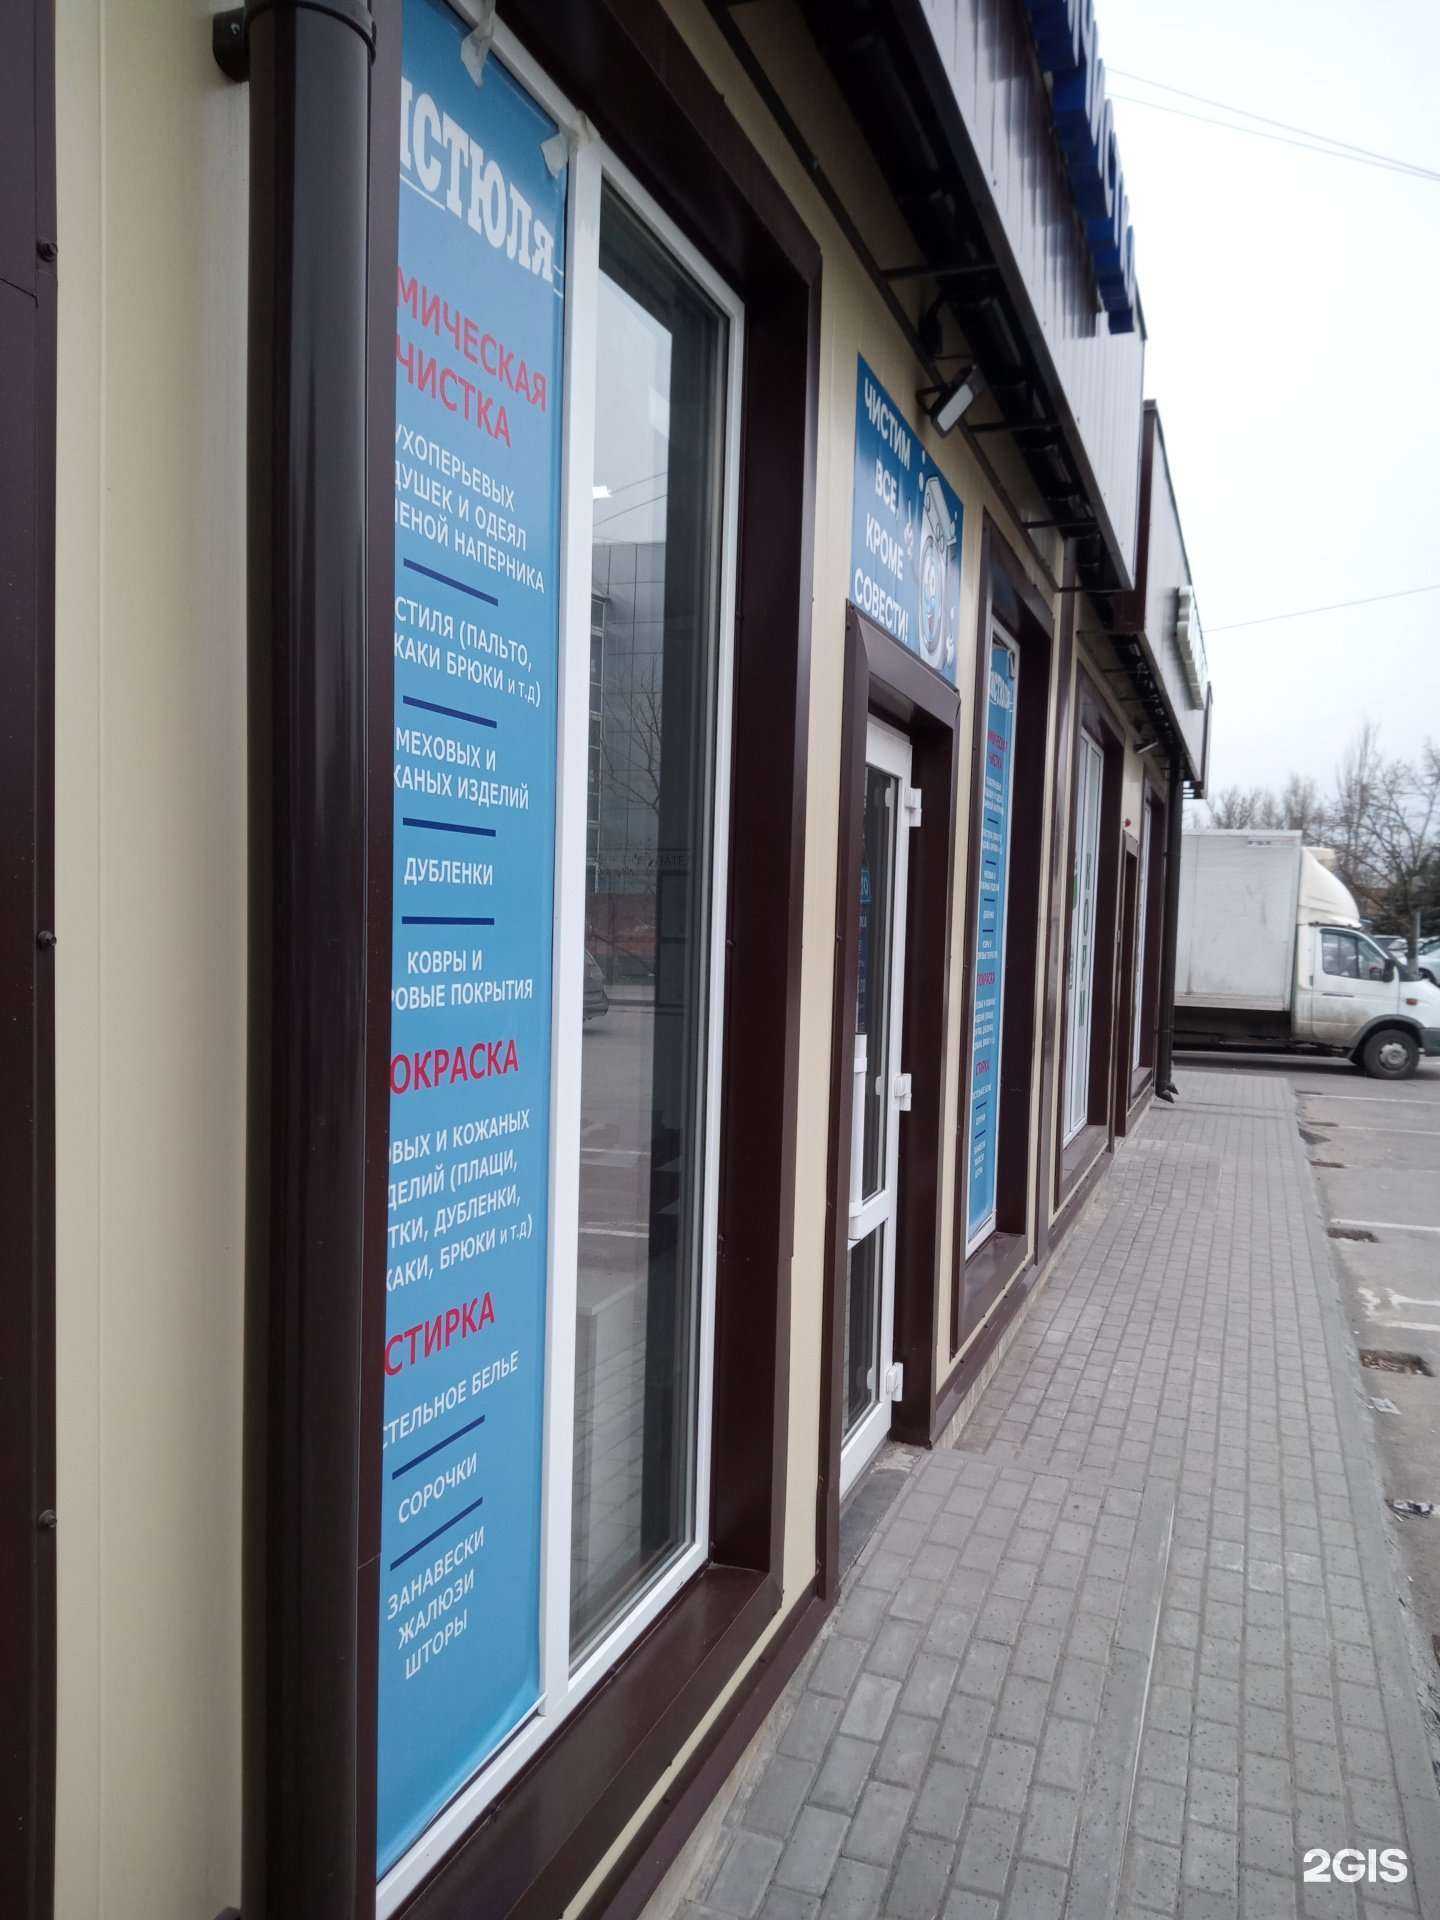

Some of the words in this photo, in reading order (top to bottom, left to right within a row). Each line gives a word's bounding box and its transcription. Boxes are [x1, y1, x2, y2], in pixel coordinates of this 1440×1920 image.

[396, 264, 547, 413] МИЧЕСКАЯ
[395, 334, 512, 449] ЧИСТКА
[864, 376, 912, 472] ЧИСТИМ
[874, 457, 901, 521] ВСЕ,
[395, 498, 449, 547] ЕНОЙ
[455, 529, 545, 593] НАПЕРНИКА
[458, 495, 470, 522] И
[475, 505, 527, 551] ОДЕЯЛ
[866, 512, 904, 581] КРОМЕ
[395, 596, 454, 640] СТИЛЯ
[459, 620, 532, 673] (ПАЛЬТО,
[854, 567, 910, 644] СОВЕСТИ!
[447, 651, 504, 691] БРЮКИ
[396, 727, 481, 769] МЕХОВЫХ
[486, 749, 496, 772] И
[457, 775, 529, 811] ИЗДЕЛИЙ
[403, 856, 494, 886] ДУБЛЕНКИ
[391, 984, 446, 1011] ОВЫЕ
[451, 978, 533, 1006] ПОКРЫТИЯ
[407, 949, 467, 975] КОВРЫ
[472, 949, 483, 971] И
[389, 1039, 519, 1095] ОКРАСКА
[389, 1133, 431, 1165] ВЫХ
[436, 1129, 448, 1153] И
[452, 1108, 531, 1148] КОЖАНЫХ
[450, 1149, 518, 1192] (ПЛАЩИ,
[387, 1216, 429, 1249] ТКИ,
[433, 1183, 521, 1238] ДУБЛЕНКИ,
[439, 1227, 496, 1270] БРЮКИ
[384, 1291, 495, 1376] СТИРКА
[471, 1350, 519, 1396] БЕЛЬЕ
[398, 1451, 477, 1524] СОРОЧКИ
[386, 1525, 485, 1621] ЗАНАВЕСКИ
[398, 1568, 475, 1650] ЖАЛЮЗИ
[404, 1608, 468, 1680] ШТОРЫ
